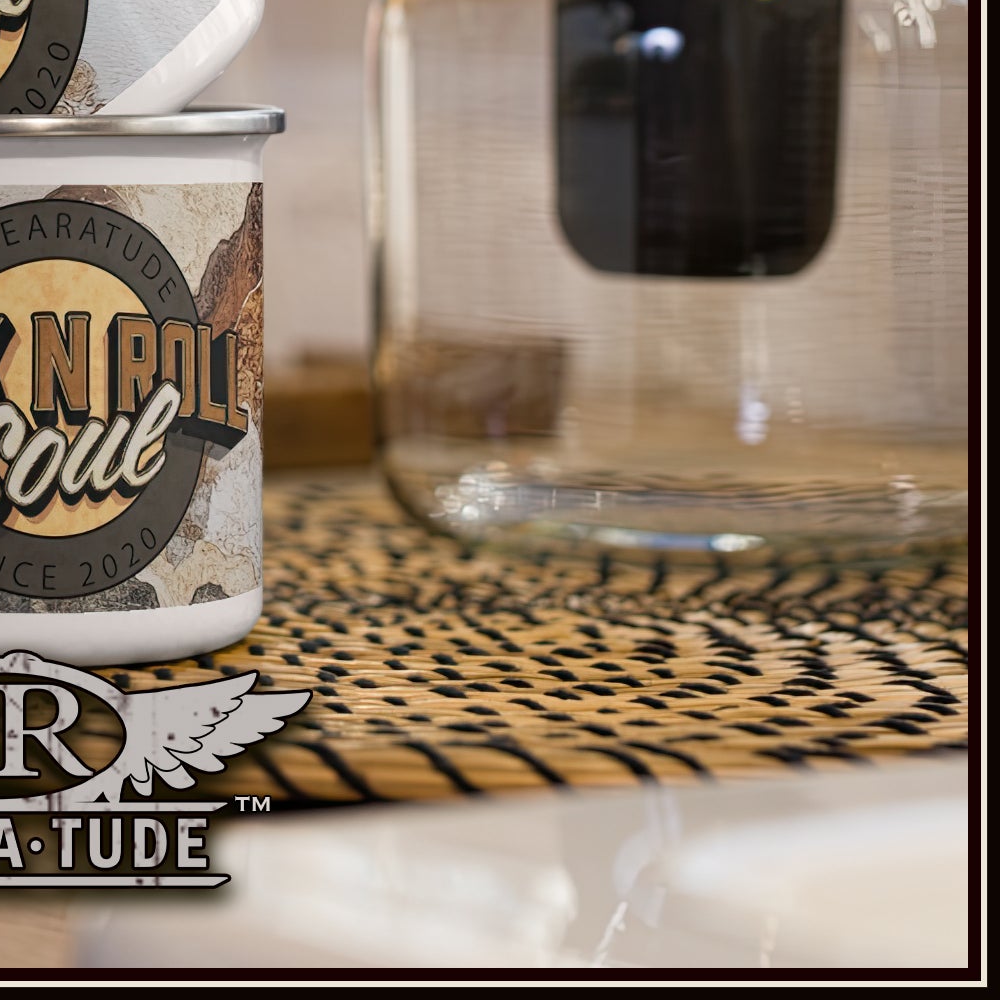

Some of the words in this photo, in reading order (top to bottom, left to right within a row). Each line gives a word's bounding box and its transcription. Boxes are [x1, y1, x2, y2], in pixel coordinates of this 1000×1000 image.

[31, 311, 92, 417] N
[112, 312, 249, 434] ROLL
[79, 527, 157, 588] 2020
